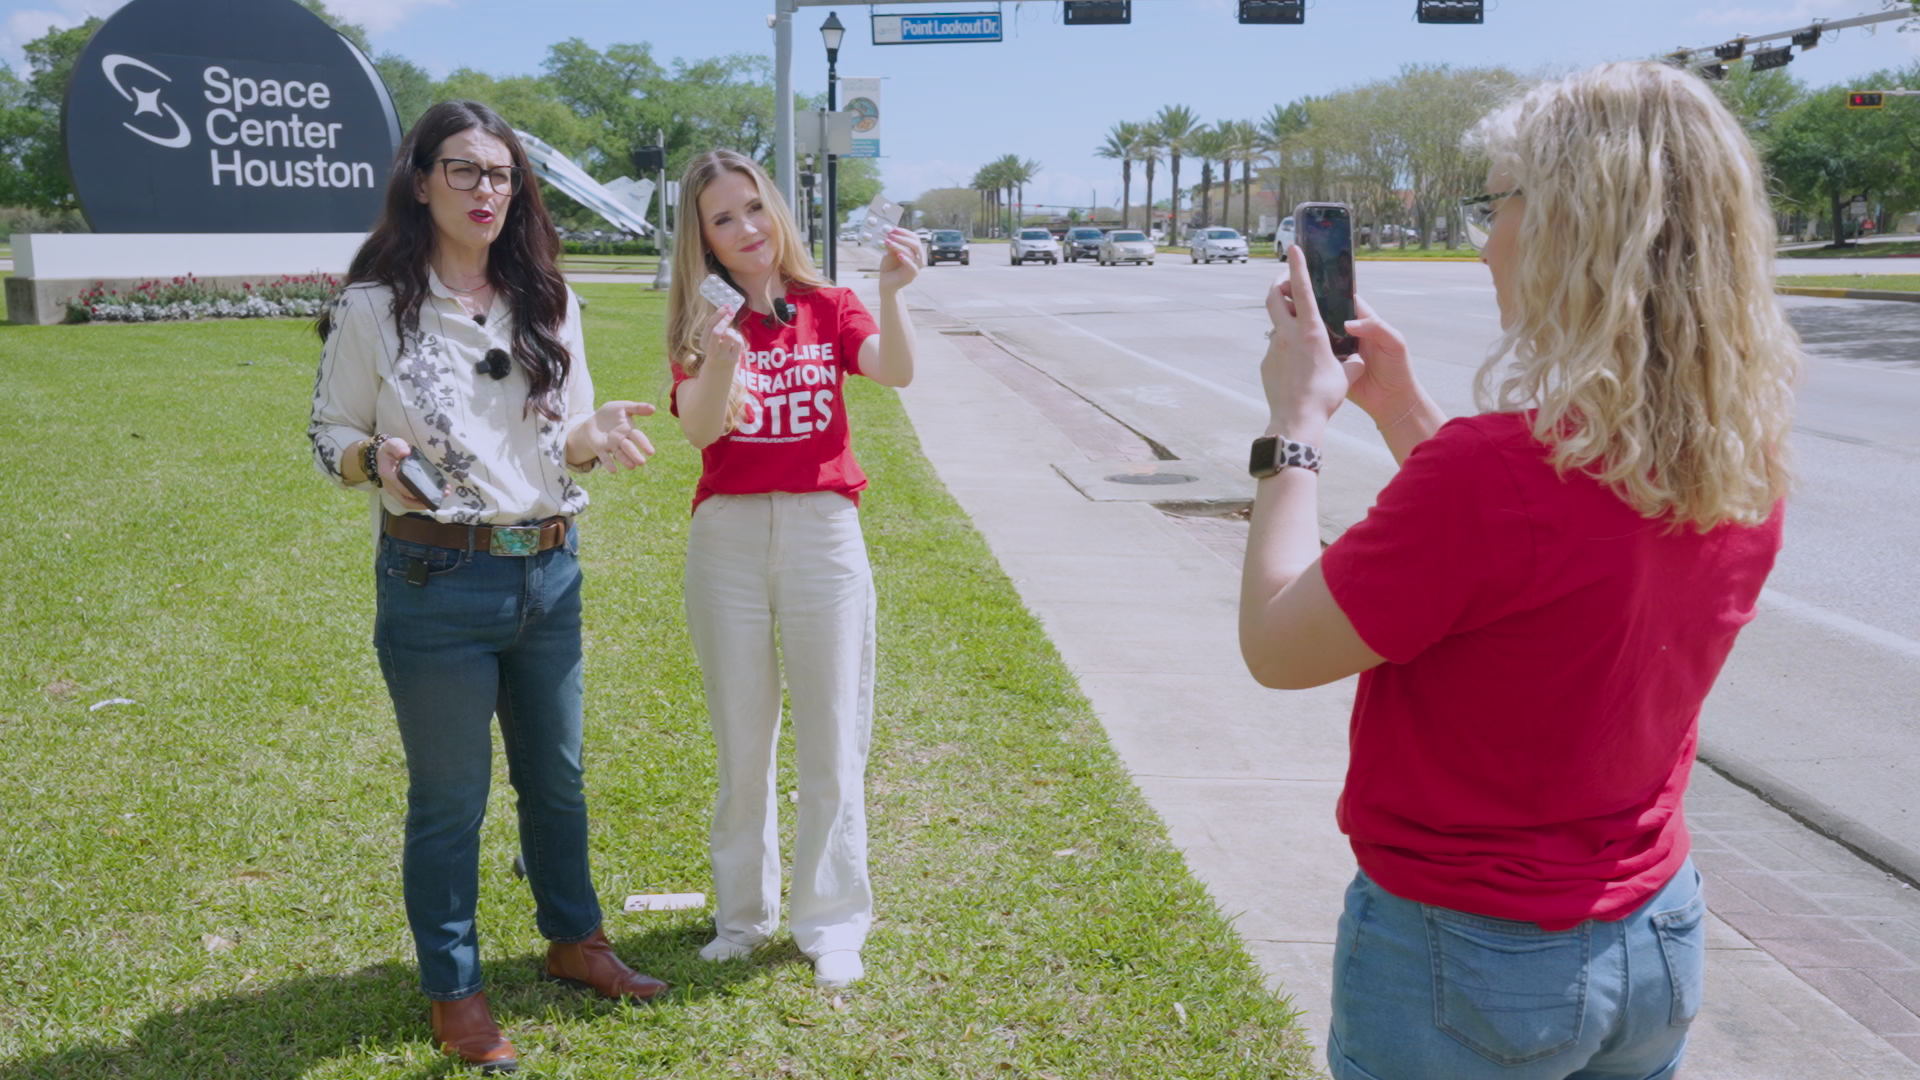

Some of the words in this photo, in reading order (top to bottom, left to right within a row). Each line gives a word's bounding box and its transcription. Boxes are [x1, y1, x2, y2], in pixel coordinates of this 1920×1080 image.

[903, 19, 933, 36] Point
[934, 19, 982, 35] Lookout
[983, 18, 999, 34] Dr.
[203, 66, 331, 112] Space
[206, 108, 342, 149] Center
[210, 149, 375, 188] Houston
[745, 342, 834, 370] PRO-LIFE
[737, 364, 837, 393] NERATION
[738, 389, 834, 435] OTES
